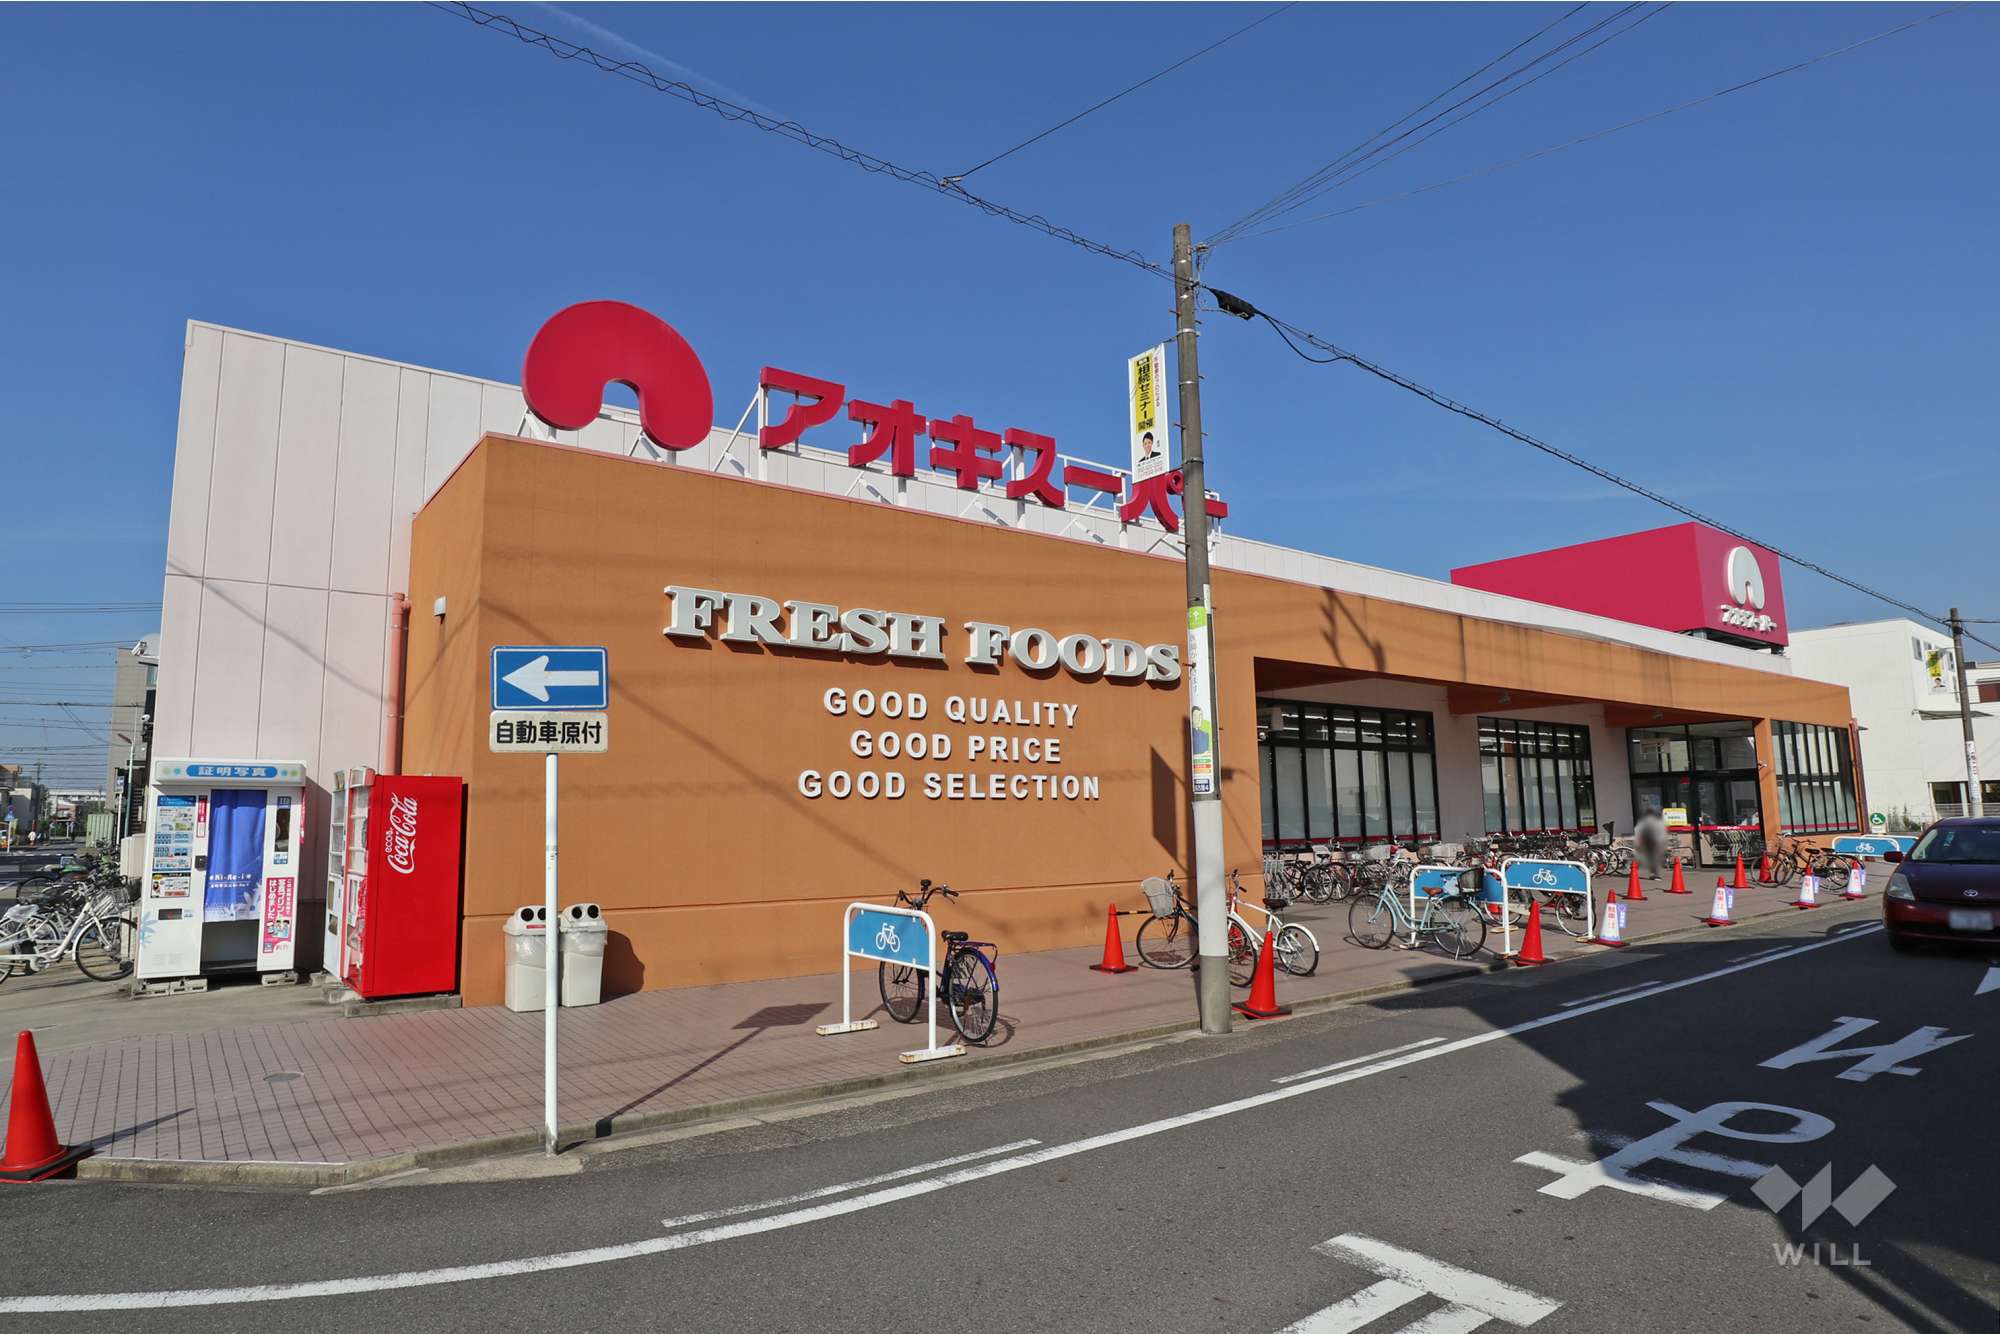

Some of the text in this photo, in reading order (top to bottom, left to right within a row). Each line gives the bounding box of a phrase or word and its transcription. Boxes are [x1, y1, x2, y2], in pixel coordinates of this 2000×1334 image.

[663, 585, 945, 659] FRESH
[964, 621, 1182, 683] FOODS
[823, 687, 1079, 727] GOOD QUALITY
[850, 730, 1062, 763] GOOD PRICE
[198, 766, 267, 777] 証明写真
[798, 769, 1101, 800] GOOD SELECTION
